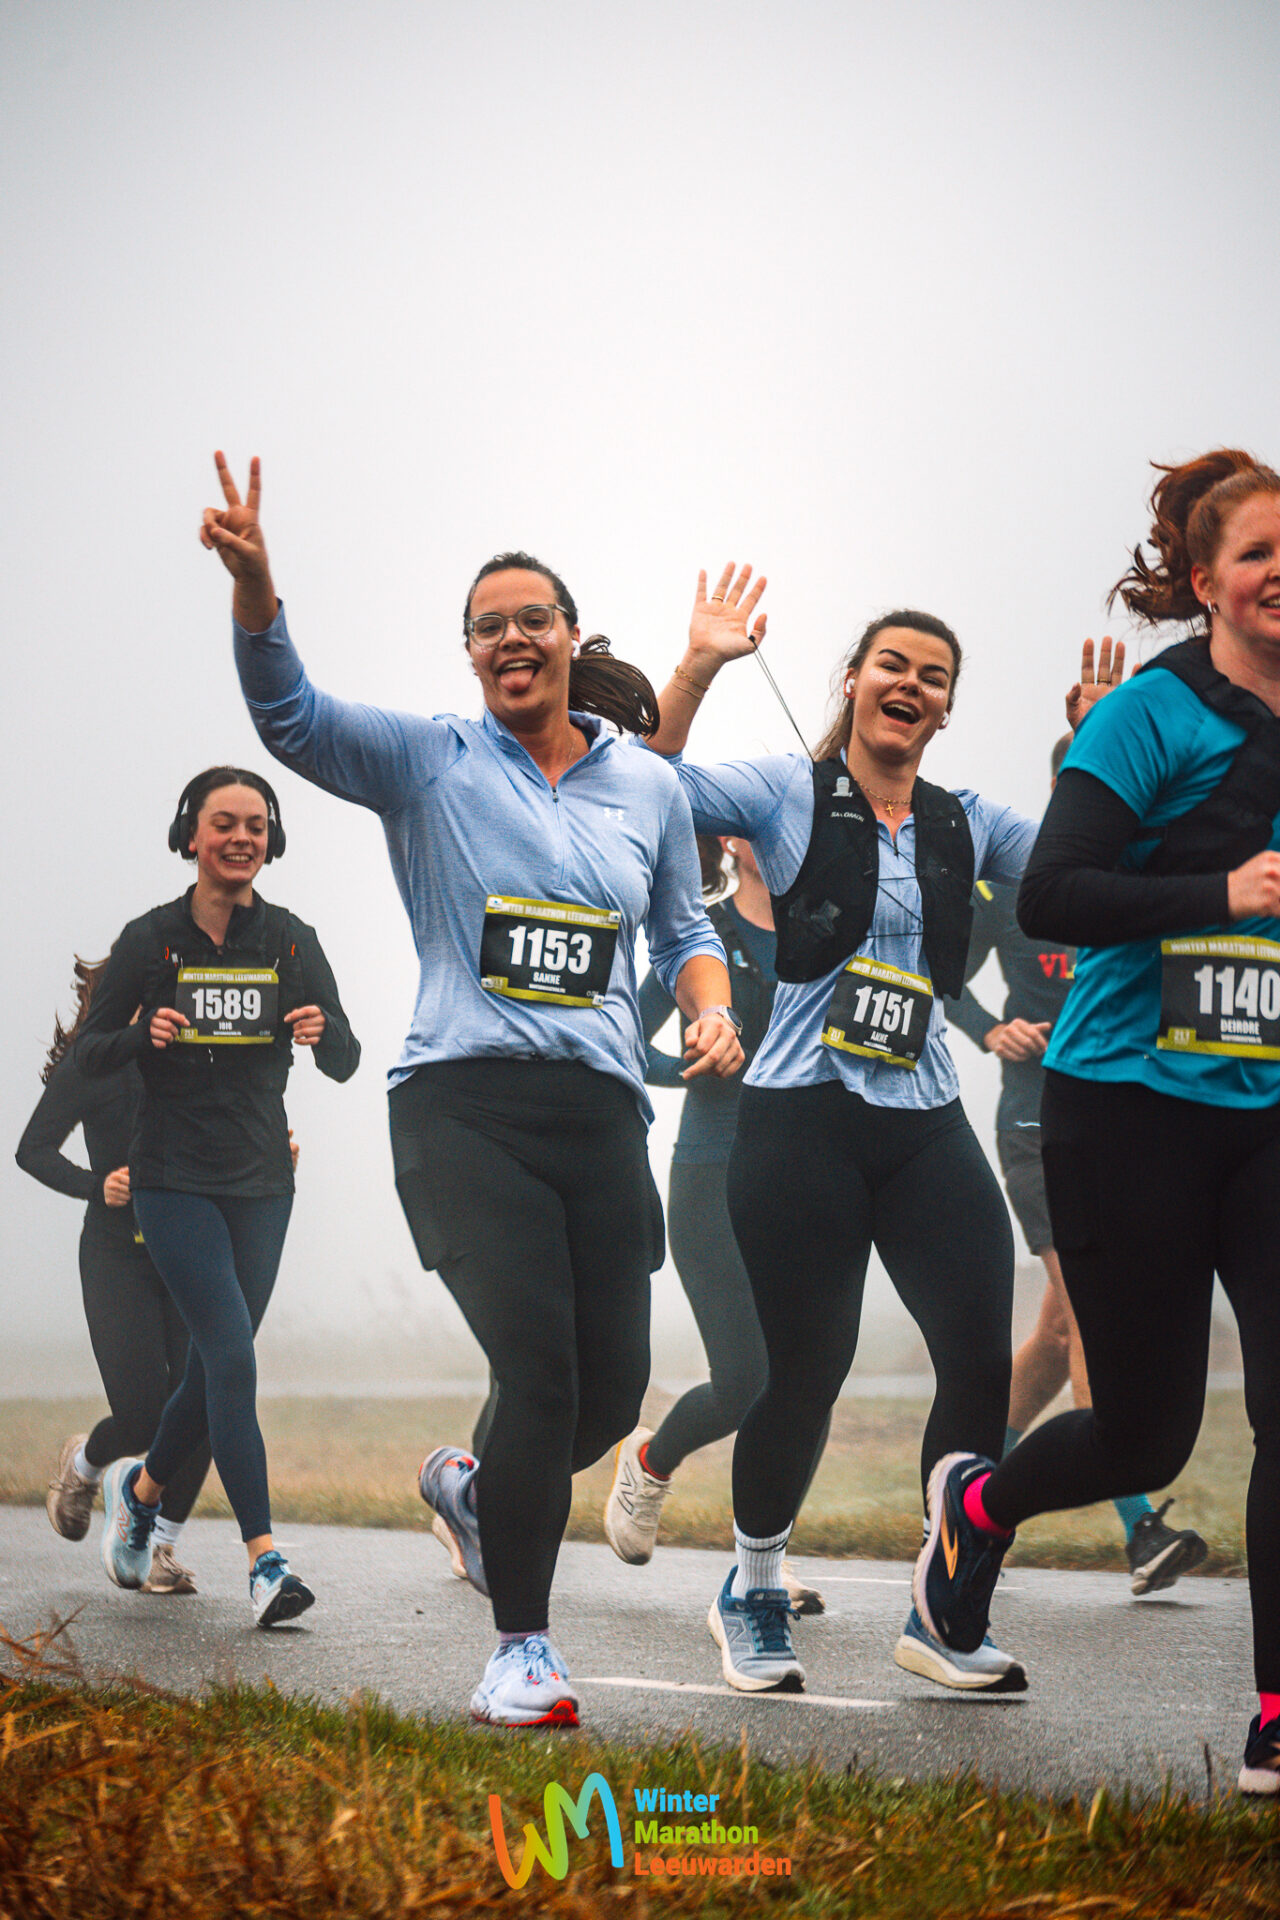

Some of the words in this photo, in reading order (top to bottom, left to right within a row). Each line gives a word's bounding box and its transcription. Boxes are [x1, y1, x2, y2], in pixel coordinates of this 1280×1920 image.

[508, 925, 593, 975] 1153
[533, 971, 561, 986] SANNE
[1194, 964, 1280, 1020] 1140
[191, 988, 262, 1020] 1589
[853, 985, 915, 1036] 1151
